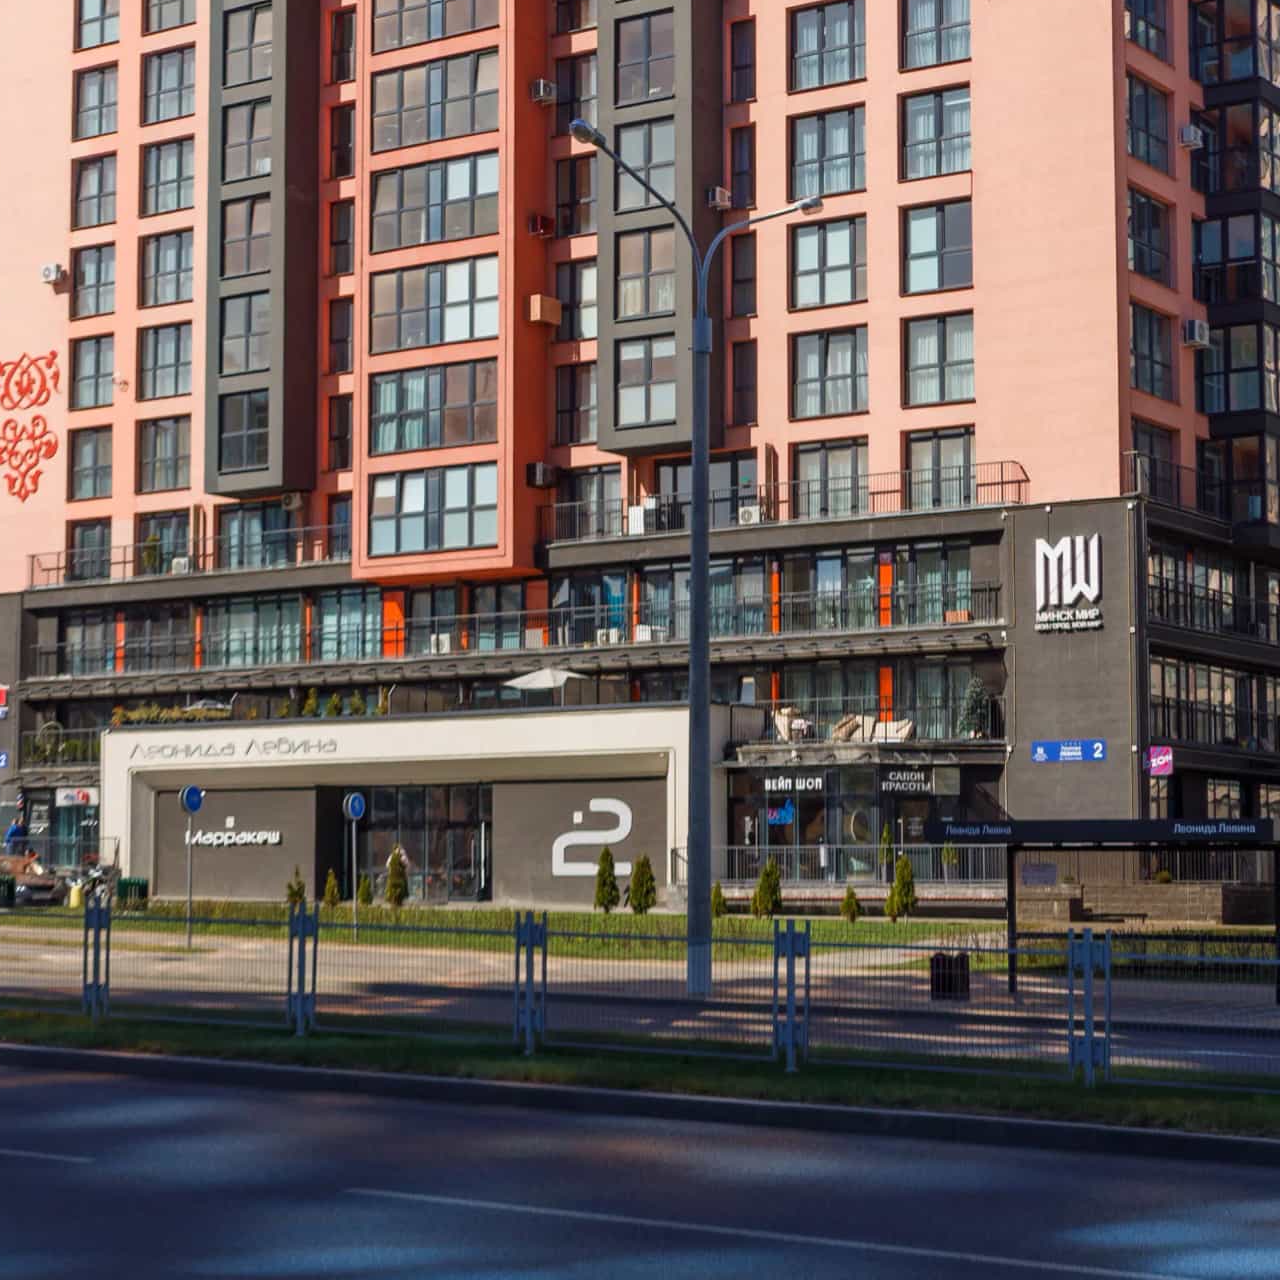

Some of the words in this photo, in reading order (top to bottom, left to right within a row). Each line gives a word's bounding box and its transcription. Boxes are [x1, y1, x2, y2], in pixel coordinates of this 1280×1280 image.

[1035, 610, 1074, 623] МИНСК
[1076, 608, 1100, 620] МИР
[130, 743, 236, 760] Леонида
[245, 737, 338, 757] Левина
[1093, 742, 1103, 758] 2
[765, 775, 792, 791] ВЕЙП
[795, 777, 822, 791] ШОП
[888, 771, 925, 782] САЛОН
[881, 781, 931, 792] КРАСОТЫ
[184, 830, 281, 848] Марракеш
[552, 797, 632, 876] 2
